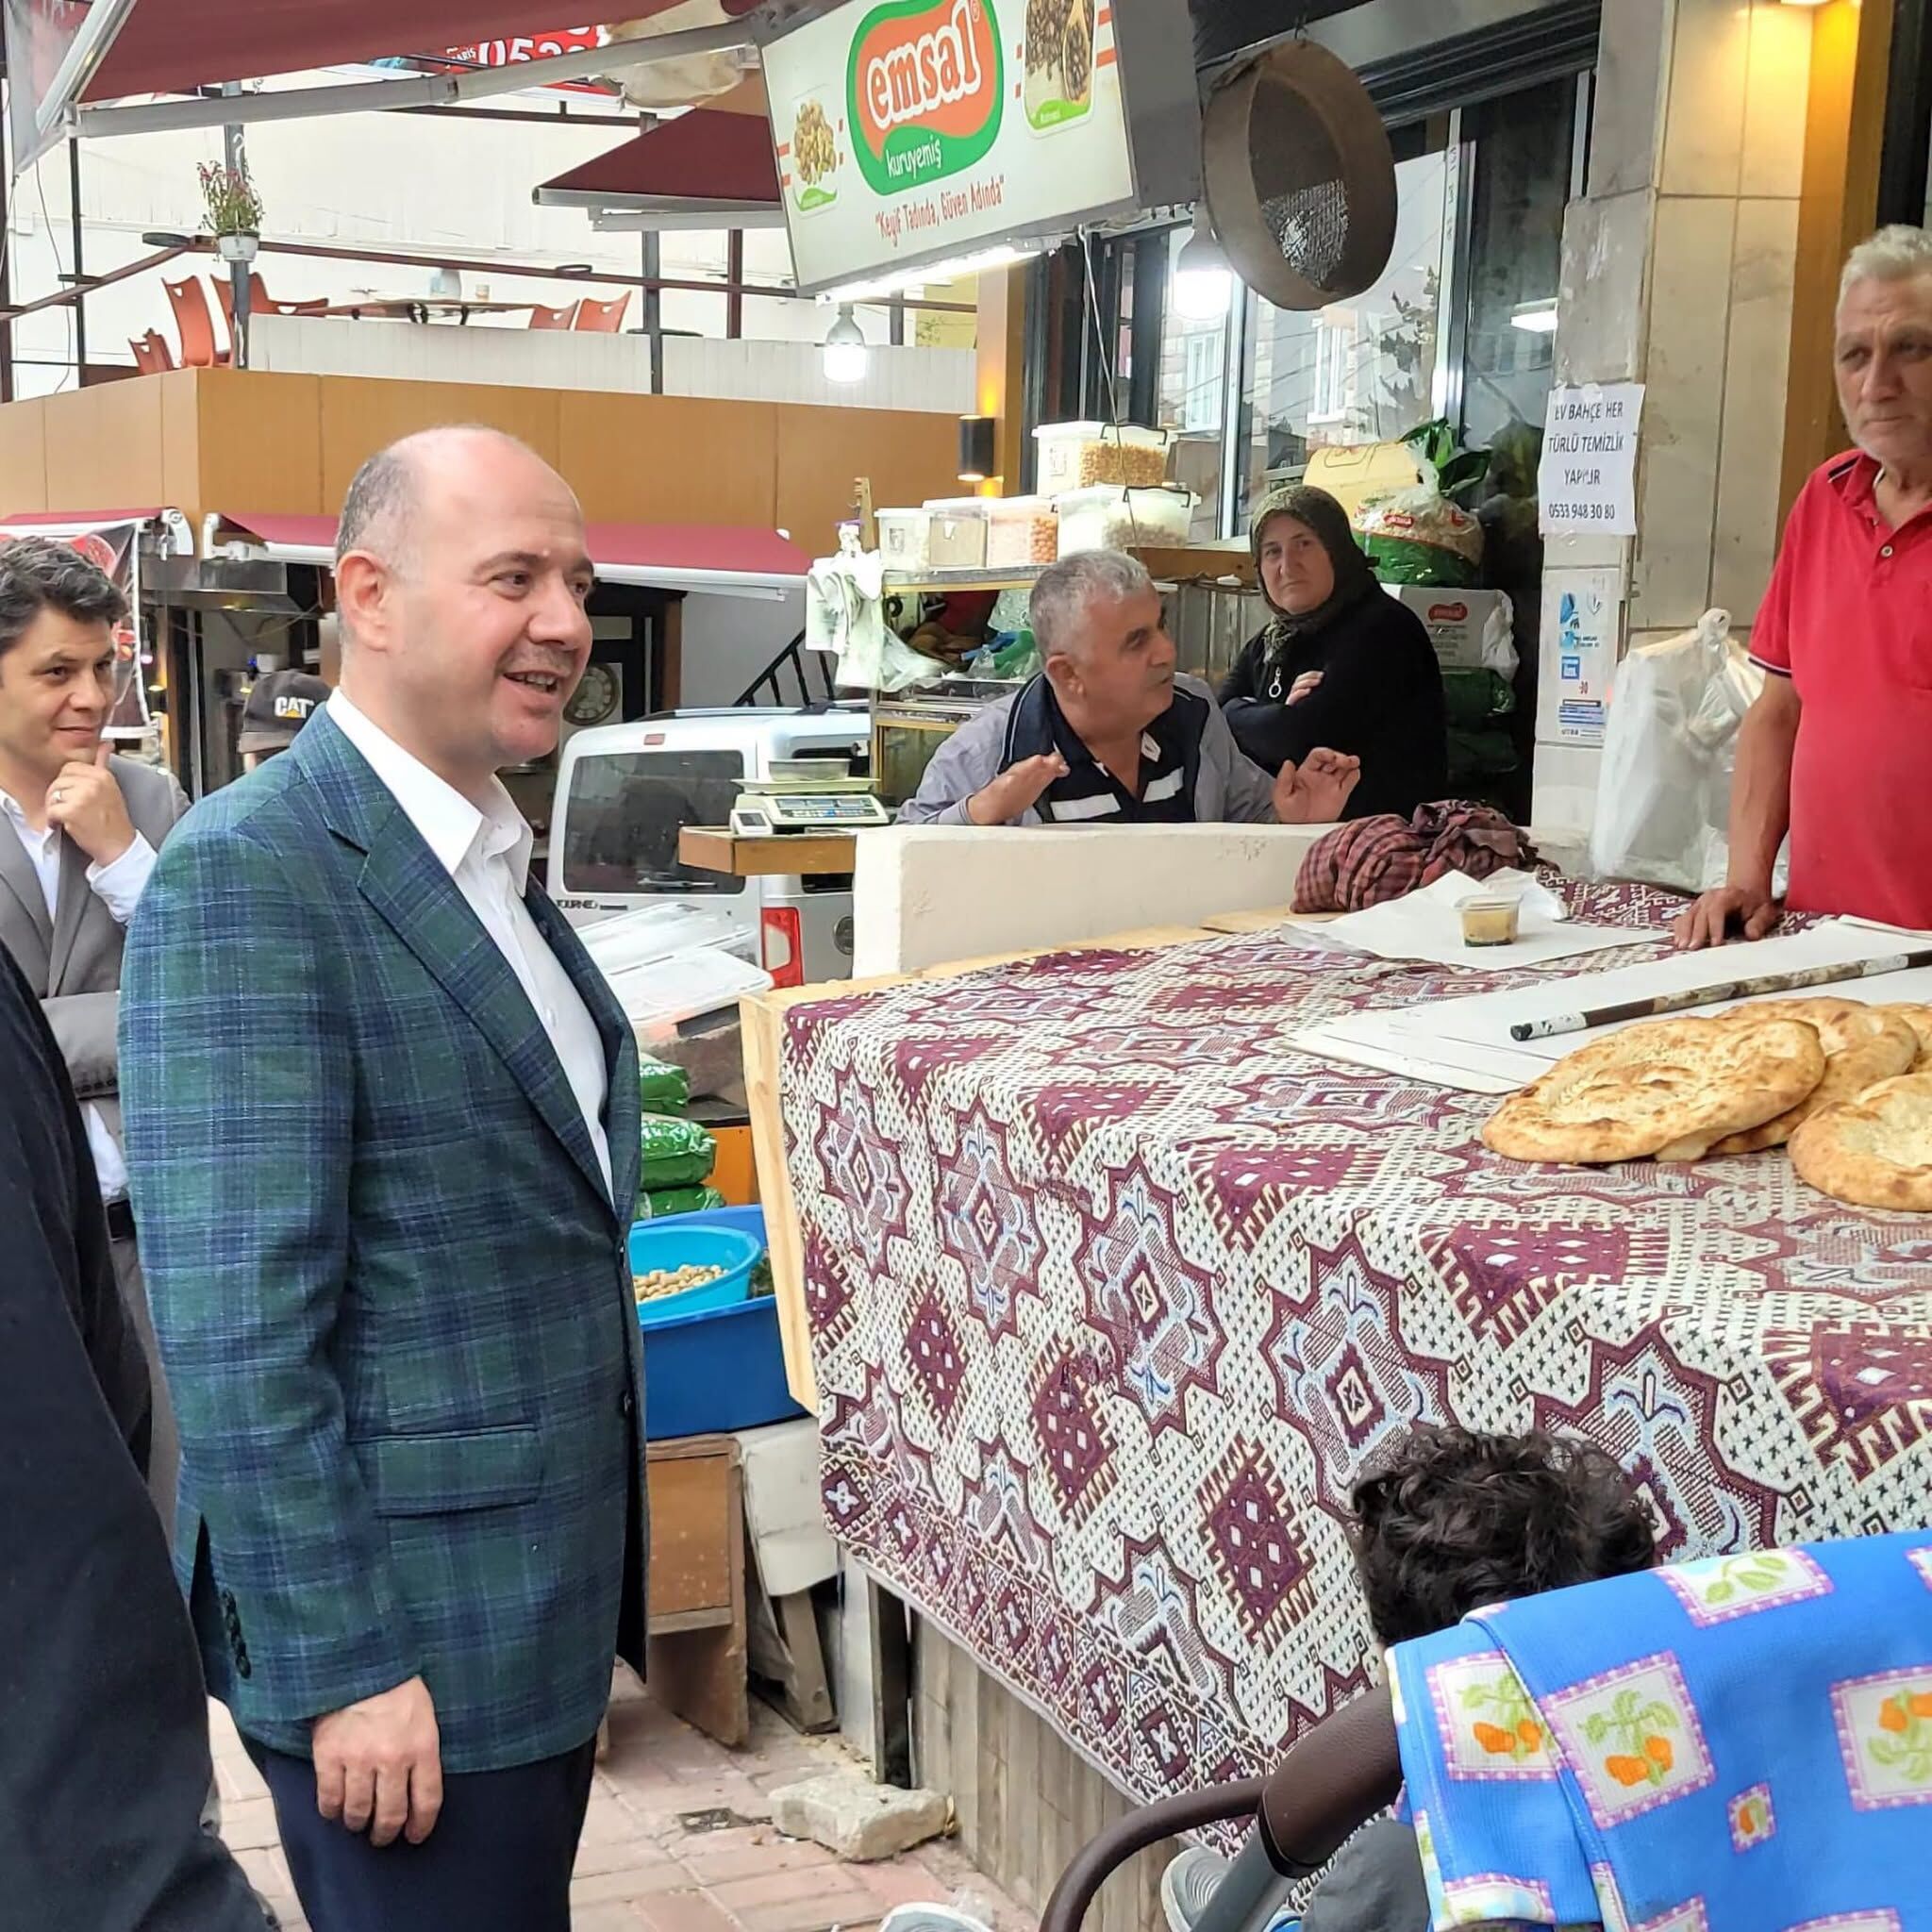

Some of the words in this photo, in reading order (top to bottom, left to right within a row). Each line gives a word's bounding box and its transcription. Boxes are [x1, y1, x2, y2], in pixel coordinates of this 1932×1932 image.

[868, 0, 981, 129] emsal
[886, 135, 941, 179] kuruyemiş
[903, 197, 941, 230] Tadında,
[941, 192, 968, 221] Güven
[1568, 403, 1602, 424] BAHÇE
[1606, 402, 1624, 418] HER
[1549, 433, 1579, 453] TÜRLÜ
[1582, 431, 1624, 453] TEMİZLİK
[1549, 503, 1570, 519] 0533
[1572, 503, 1589, 520] 948
[1591, 503, 1603, 520] 30
[1605, 504, 1615, 520] 80
[275, 696, 315, 719] CAT
